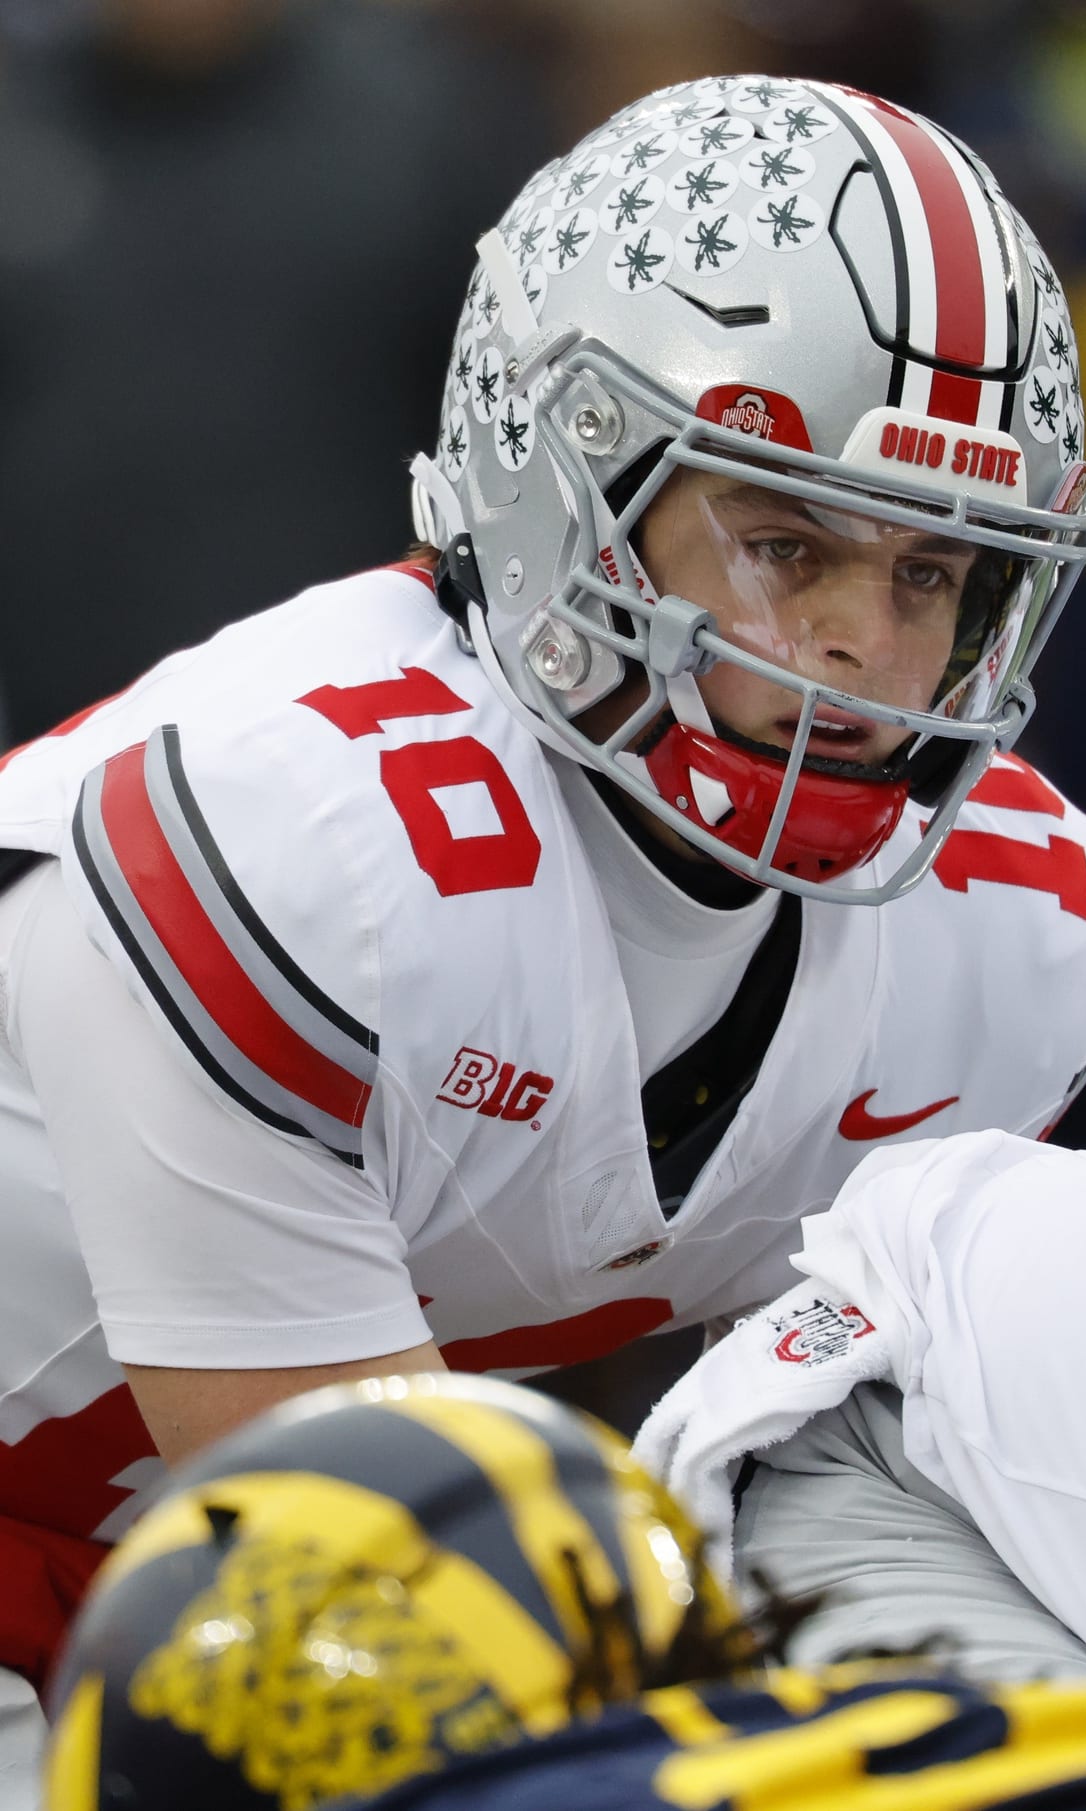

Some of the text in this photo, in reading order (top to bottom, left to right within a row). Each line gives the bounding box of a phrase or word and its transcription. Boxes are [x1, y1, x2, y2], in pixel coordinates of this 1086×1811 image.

[879, 422, 1021, 487] OHIO STATE
[293, 666, 541, 897] 10
